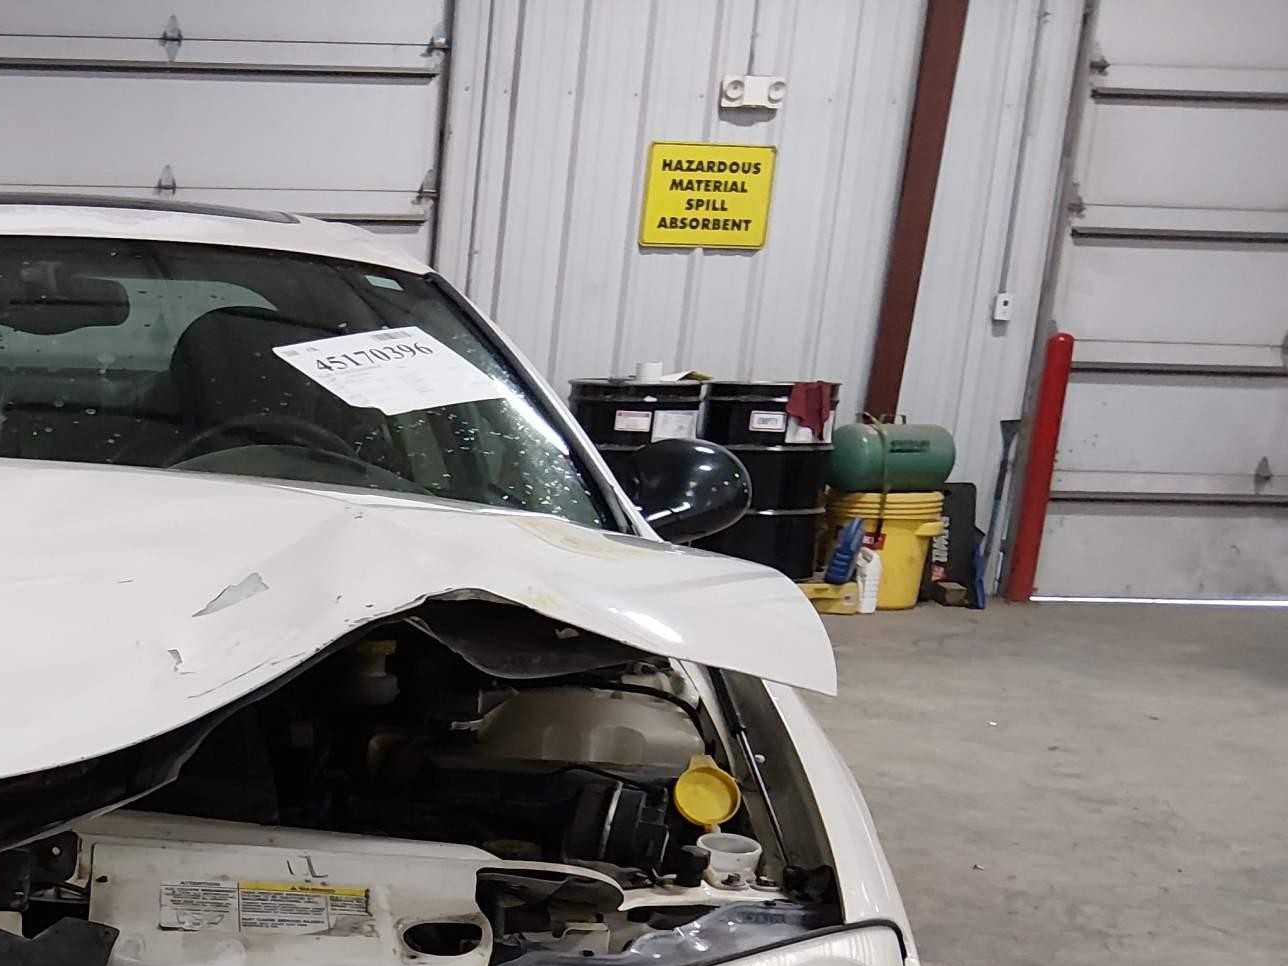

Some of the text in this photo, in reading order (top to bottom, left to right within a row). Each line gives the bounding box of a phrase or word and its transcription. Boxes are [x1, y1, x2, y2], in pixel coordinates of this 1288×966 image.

[661, 158, 762, 175] HAZARDOUS
[669, 178, 748, 193] MATERIAL
[684, 197, 728, 212] SPILL
[656, 216, 752, 232] ABSORBENT
[316, 342, 434, 372] 45170396
